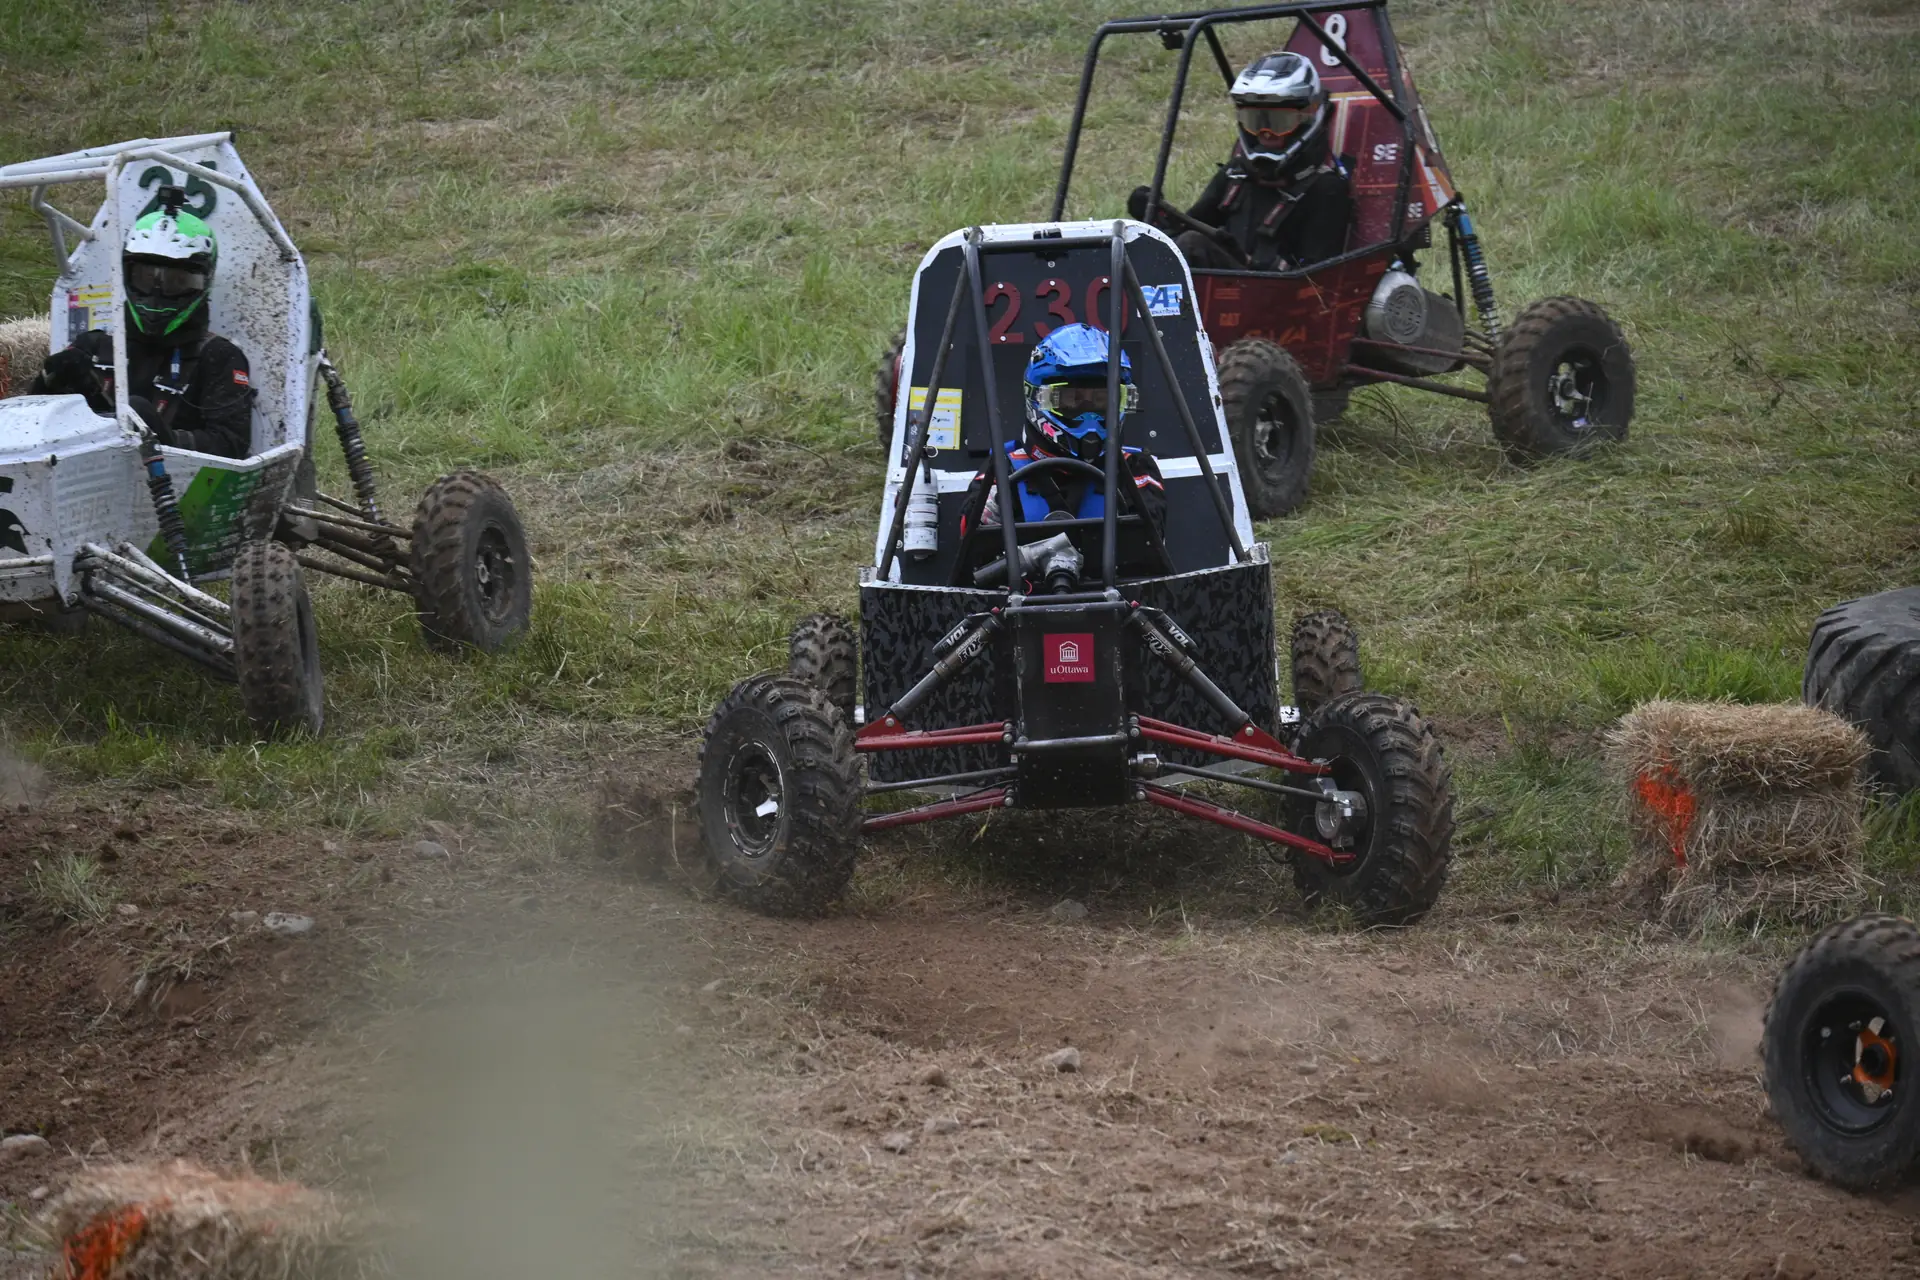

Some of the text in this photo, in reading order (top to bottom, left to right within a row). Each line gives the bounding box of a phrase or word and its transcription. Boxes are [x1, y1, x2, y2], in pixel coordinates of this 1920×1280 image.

[1320, 13, 1347, 66] 8
[984, 276, 1128, 344] 230
[959, 634, 986, 663] FOX
[1142, 631, 1172, 660] FOX
[1050, 664, 1089, 674] uOttawa
